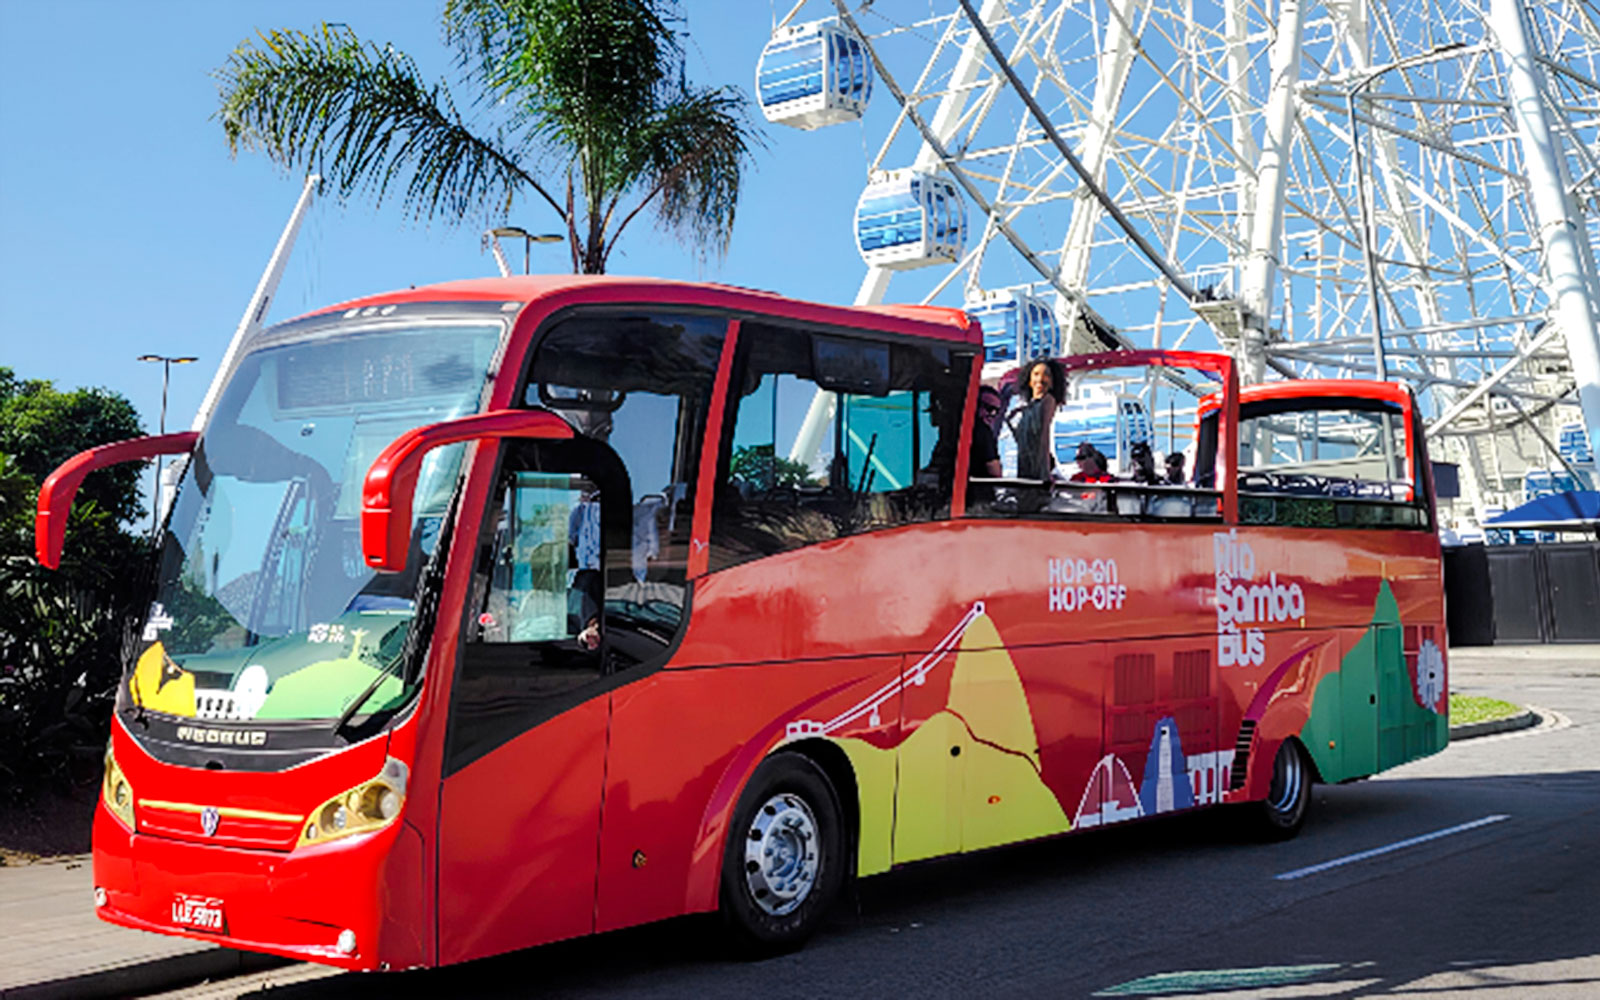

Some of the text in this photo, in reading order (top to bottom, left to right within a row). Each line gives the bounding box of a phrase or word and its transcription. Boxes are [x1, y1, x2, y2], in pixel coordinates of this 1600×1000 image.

[1213, 528, 1255, 580] Rio
[1049, 585, 1126, 611] HOP-OFF
[1216, 571, 1305, 622] Samba
[1218, 625, 1265, 667] Bus
